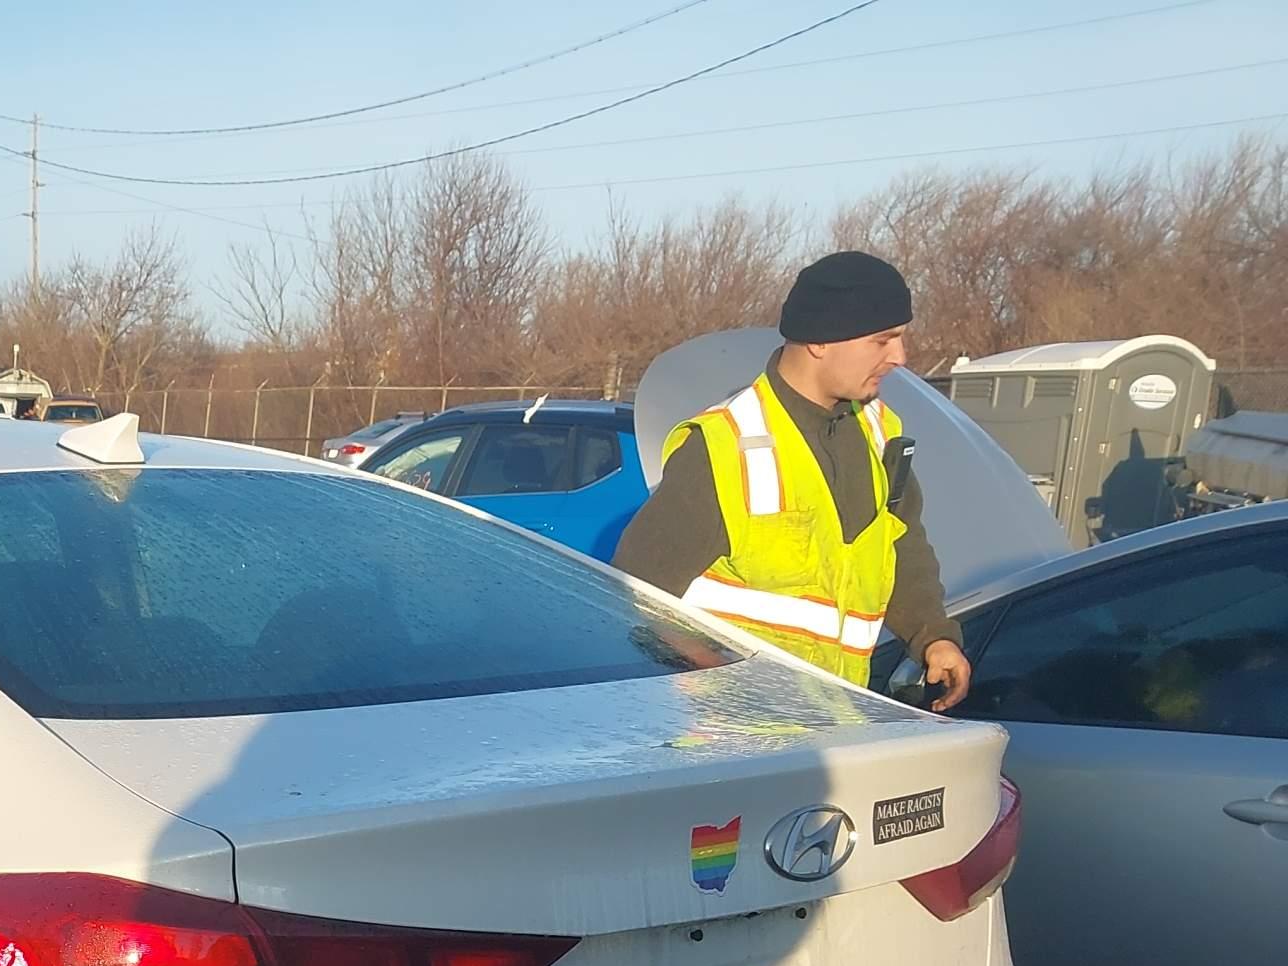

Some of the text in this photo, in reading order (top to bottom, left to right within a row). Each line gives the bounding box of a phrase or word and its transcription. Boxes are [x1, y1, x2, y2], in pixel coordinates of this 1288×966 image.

[876, 792, 942, 820] MAKE RACISTS
[878, 811, 941, 841] AFRAID AGAIN
